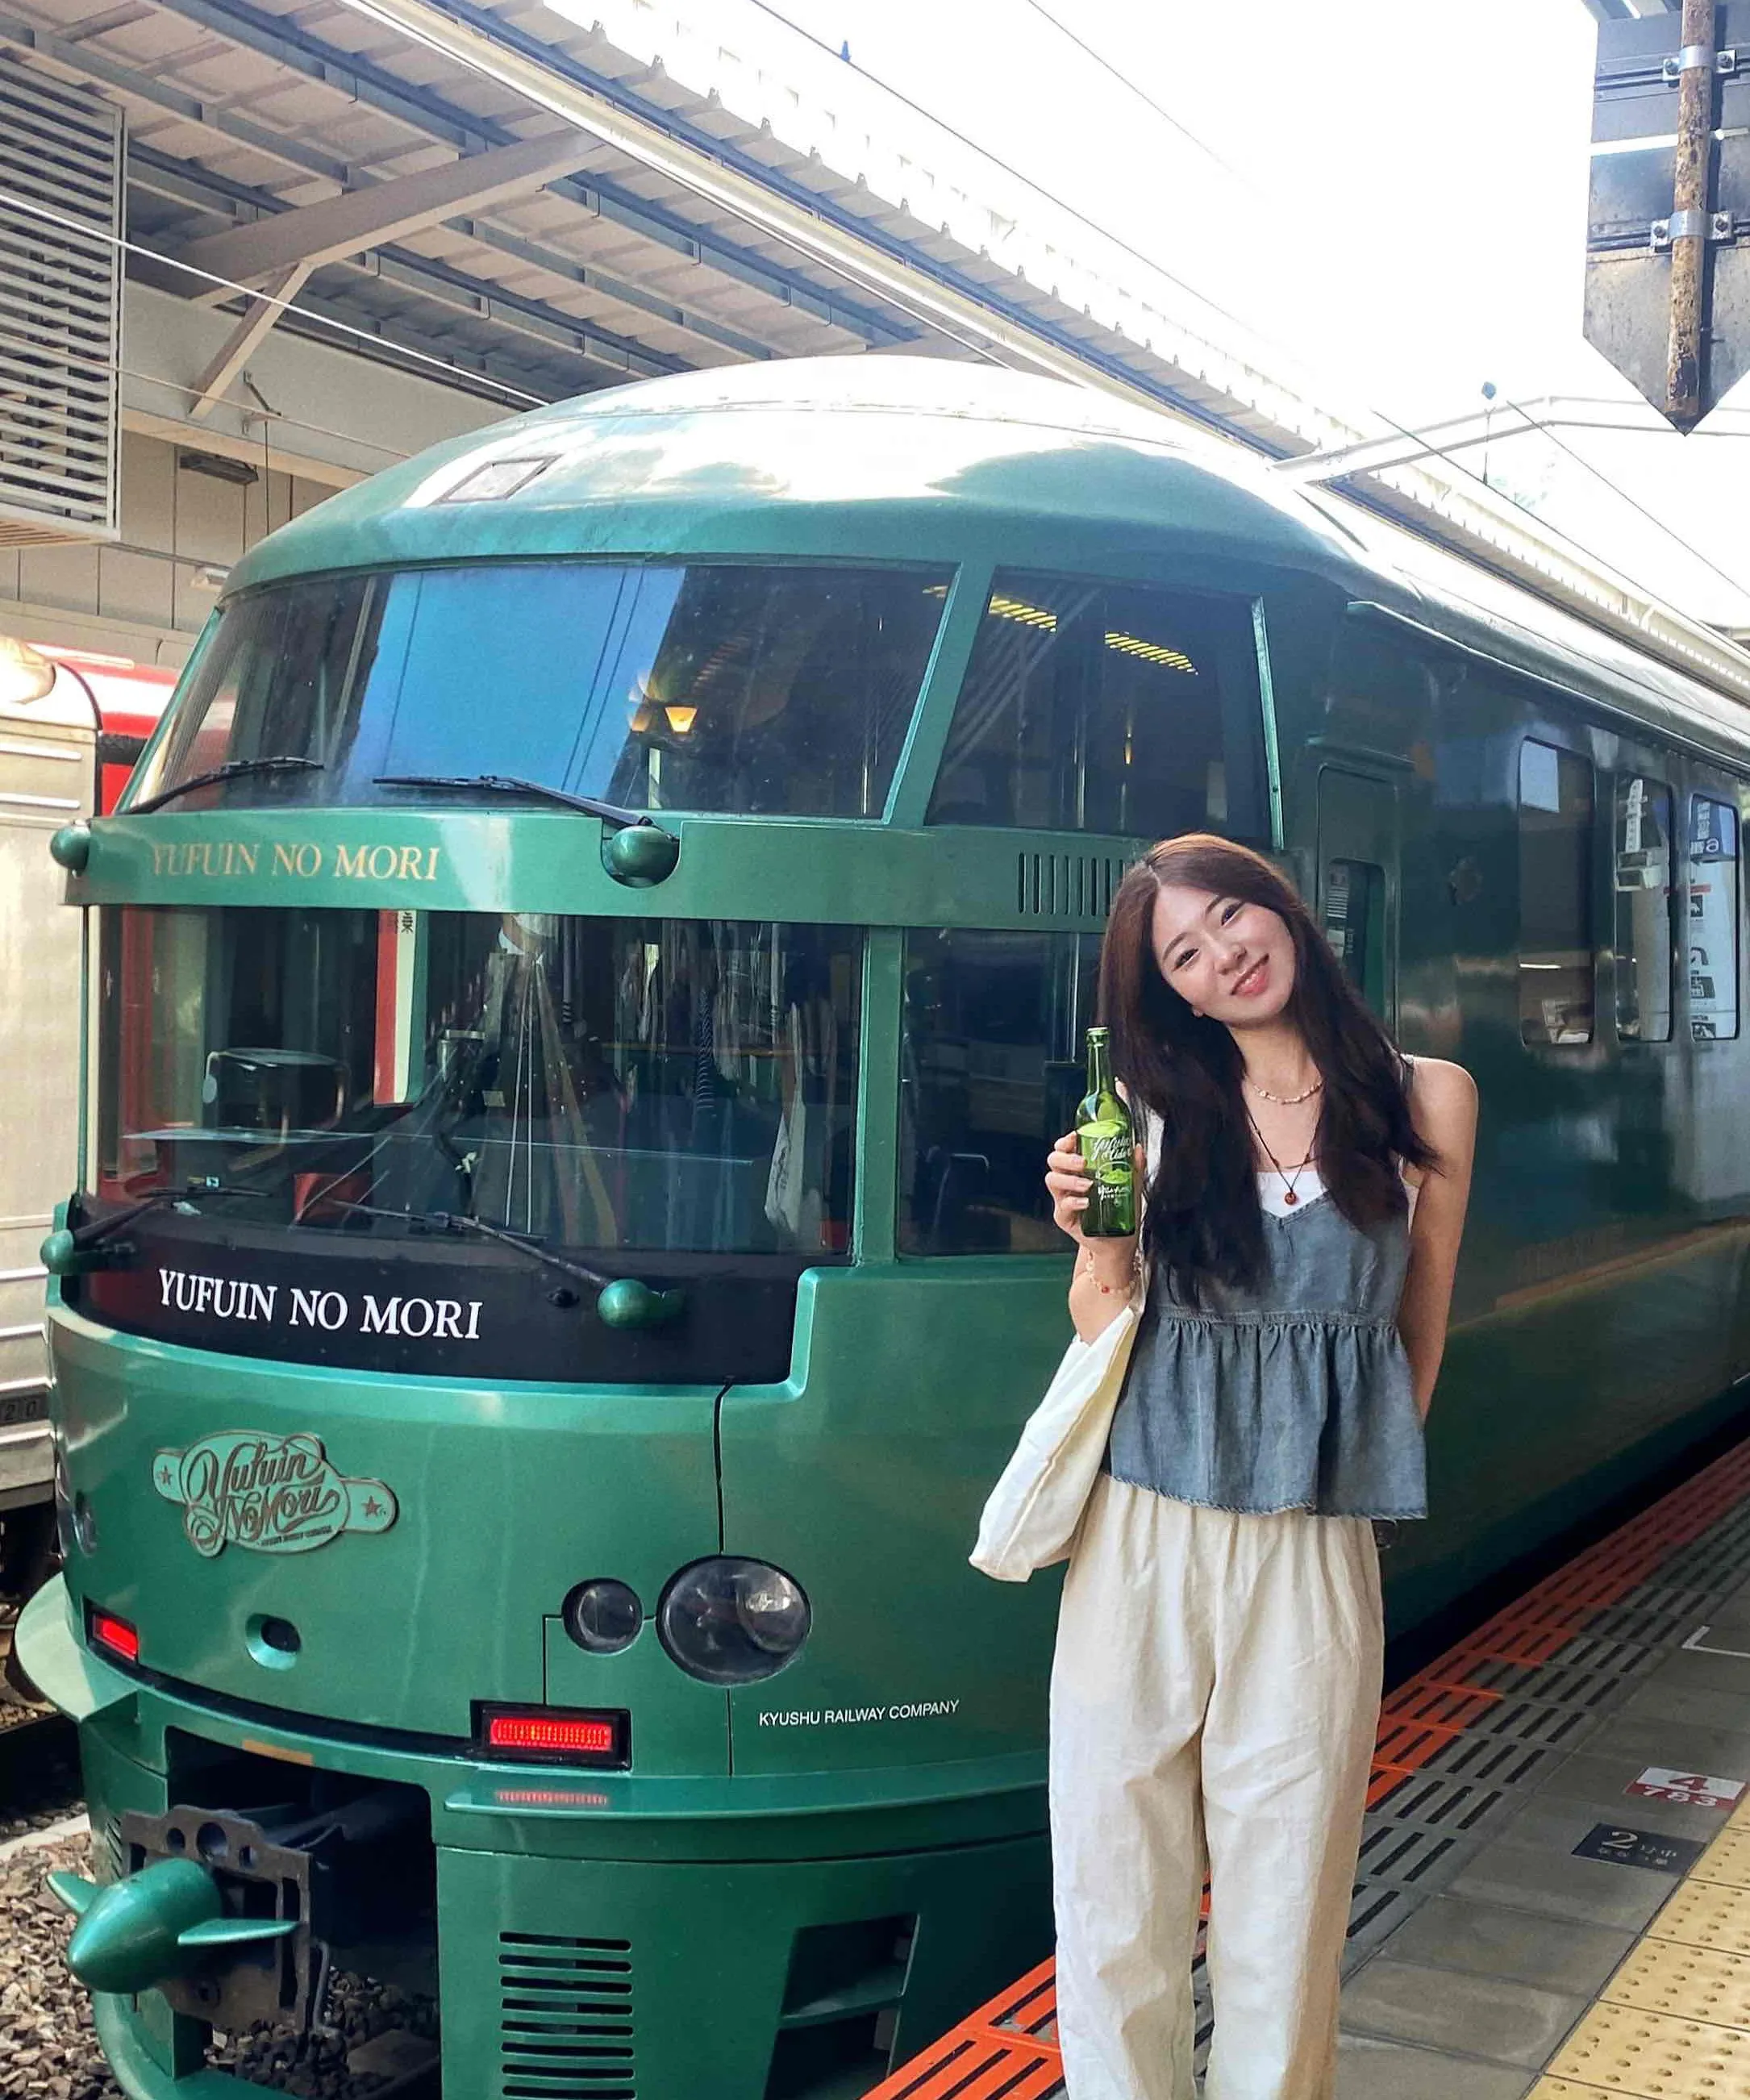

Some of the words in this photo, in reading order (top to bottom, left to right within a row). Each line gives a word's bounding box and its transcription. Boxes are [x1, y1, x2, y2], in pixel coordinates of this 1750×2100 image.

[153, 843, 260, 877] YUFUIN
[271, 843, 322, 877] NO
[332, 844, 440, 881] MORI
[159, 1269, 277, 1323] YUFUIN
[289, 1288, 348, 1331] NO
[360, 1295, 483, 1340] MORI
[759, 1710, 820, 1727] KYUSHU
[824, 1706, 885, 1724] RAILWAY
[889, 1698, 960, 1720] COMPANY
[1643, 1785, 1718, 1807] 783
[1669, 1776, 1709, 1792] 4
[1601, 1831, 1638, 1849] 2
